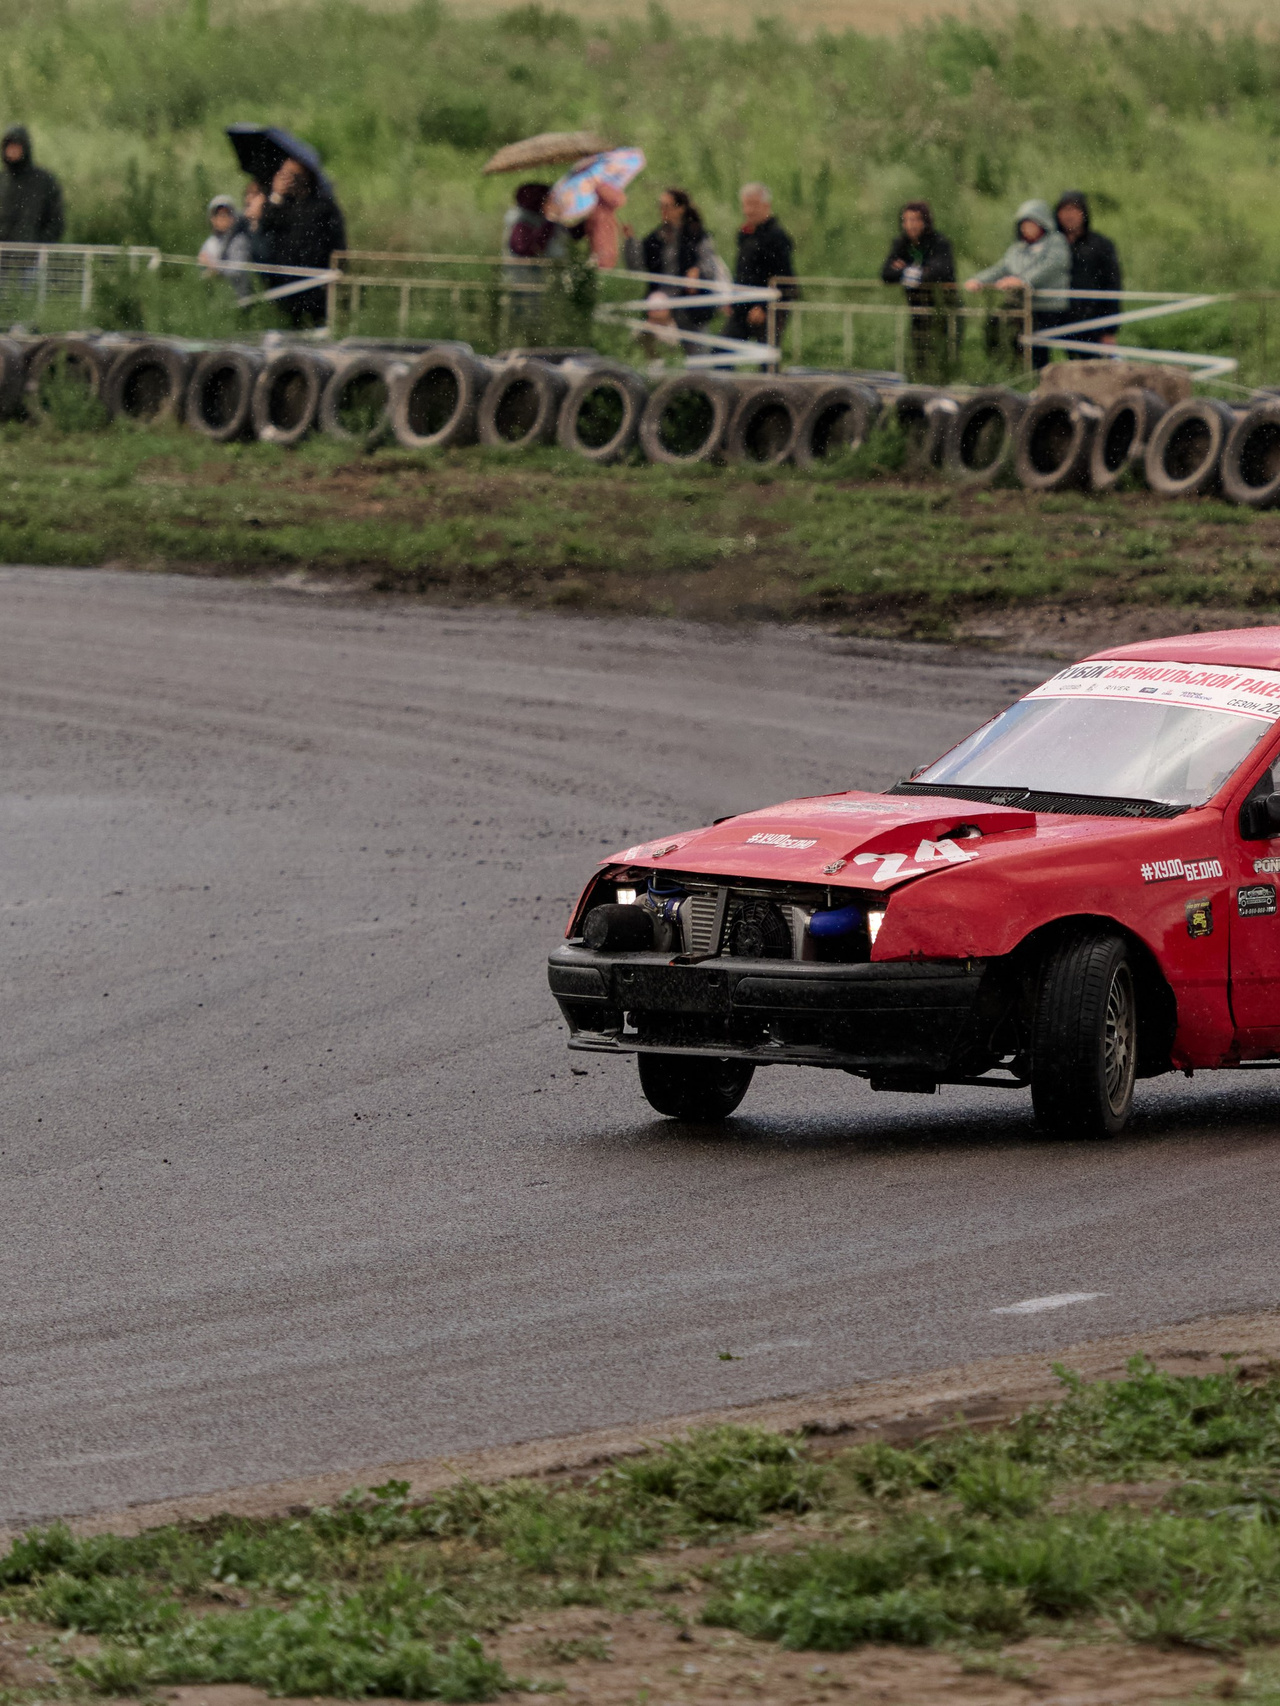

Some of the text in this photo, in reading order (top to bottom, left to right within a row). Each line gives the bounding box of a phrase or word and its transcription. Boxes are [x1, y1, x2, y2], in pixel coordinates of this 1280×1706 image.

[1103, 666, 1243, 690] БАРНАУЛЬСКОЙ
[1104, 684, 1131, 692] RIVER
[1226, 698, 1261, 710] СЕЗОН
[852, 839, 980, 883] 24
